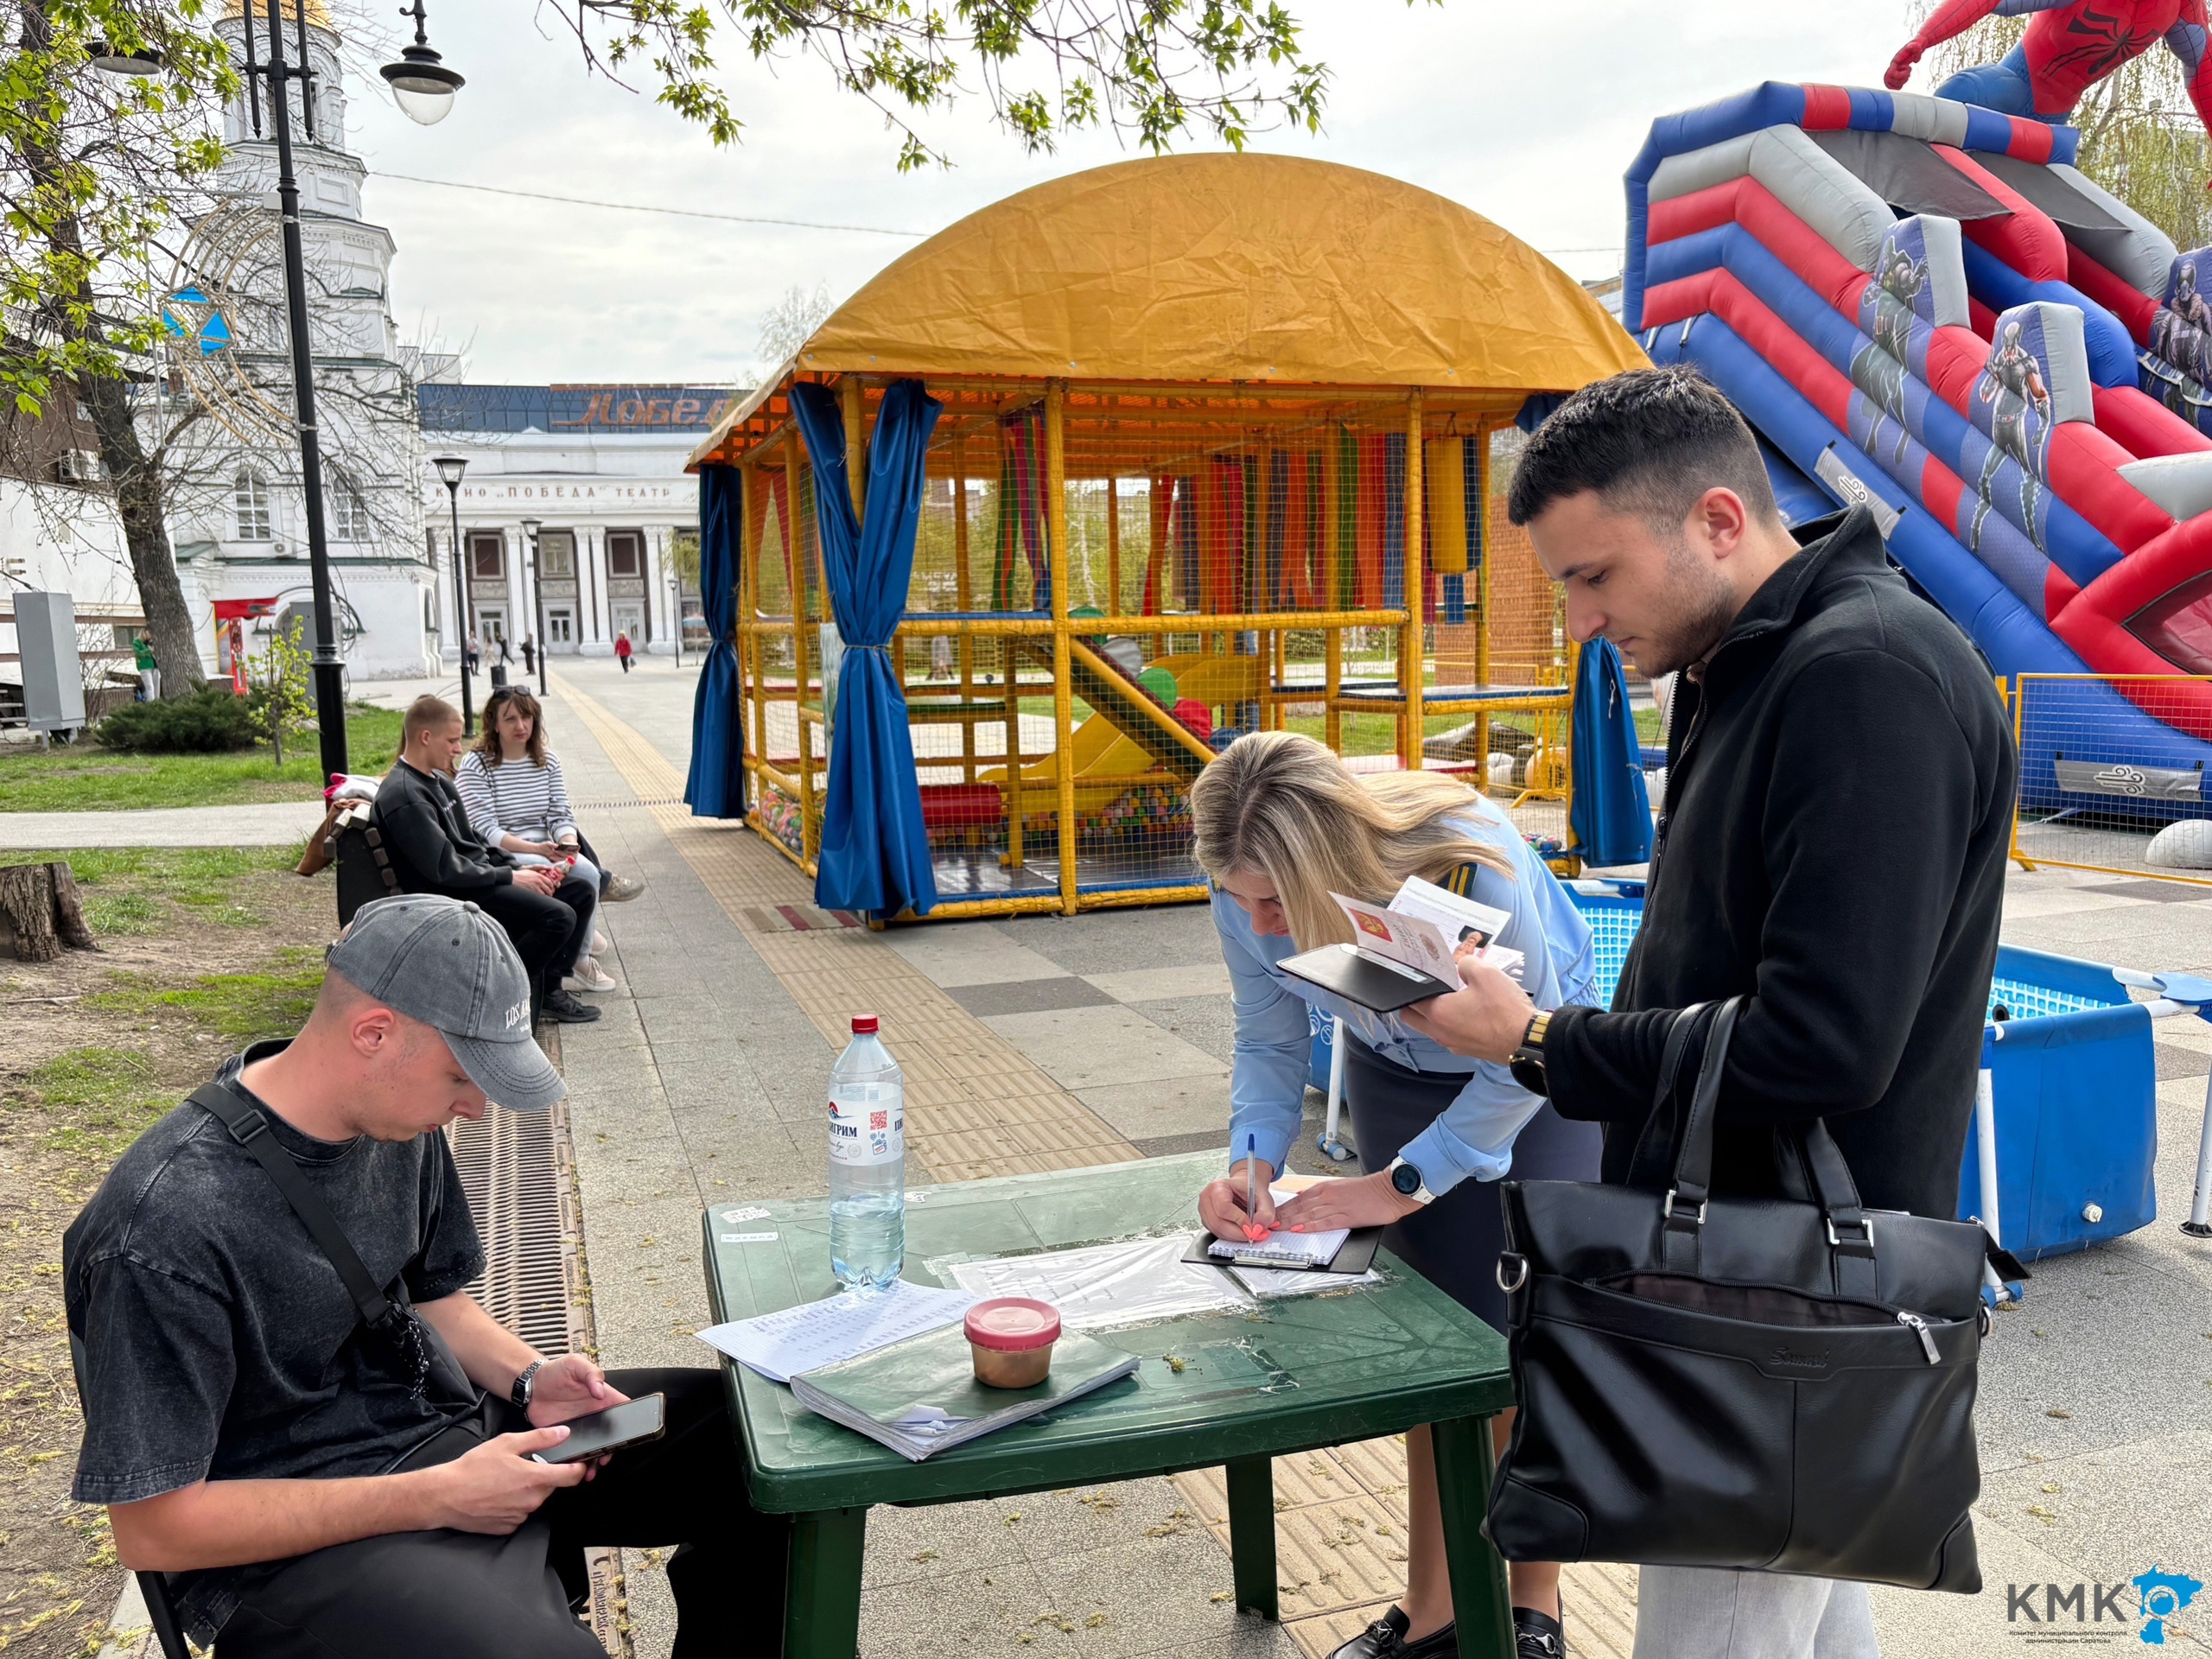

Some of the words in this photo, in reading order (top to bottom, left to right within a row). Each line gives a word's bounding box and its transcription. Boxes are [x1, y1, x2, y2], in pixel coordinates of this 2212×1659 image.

[435, 487, 486, 498] КНО
[615, 487, 671, 498] ТЕАТР
[505, 1002, 519, 1029] LOS
